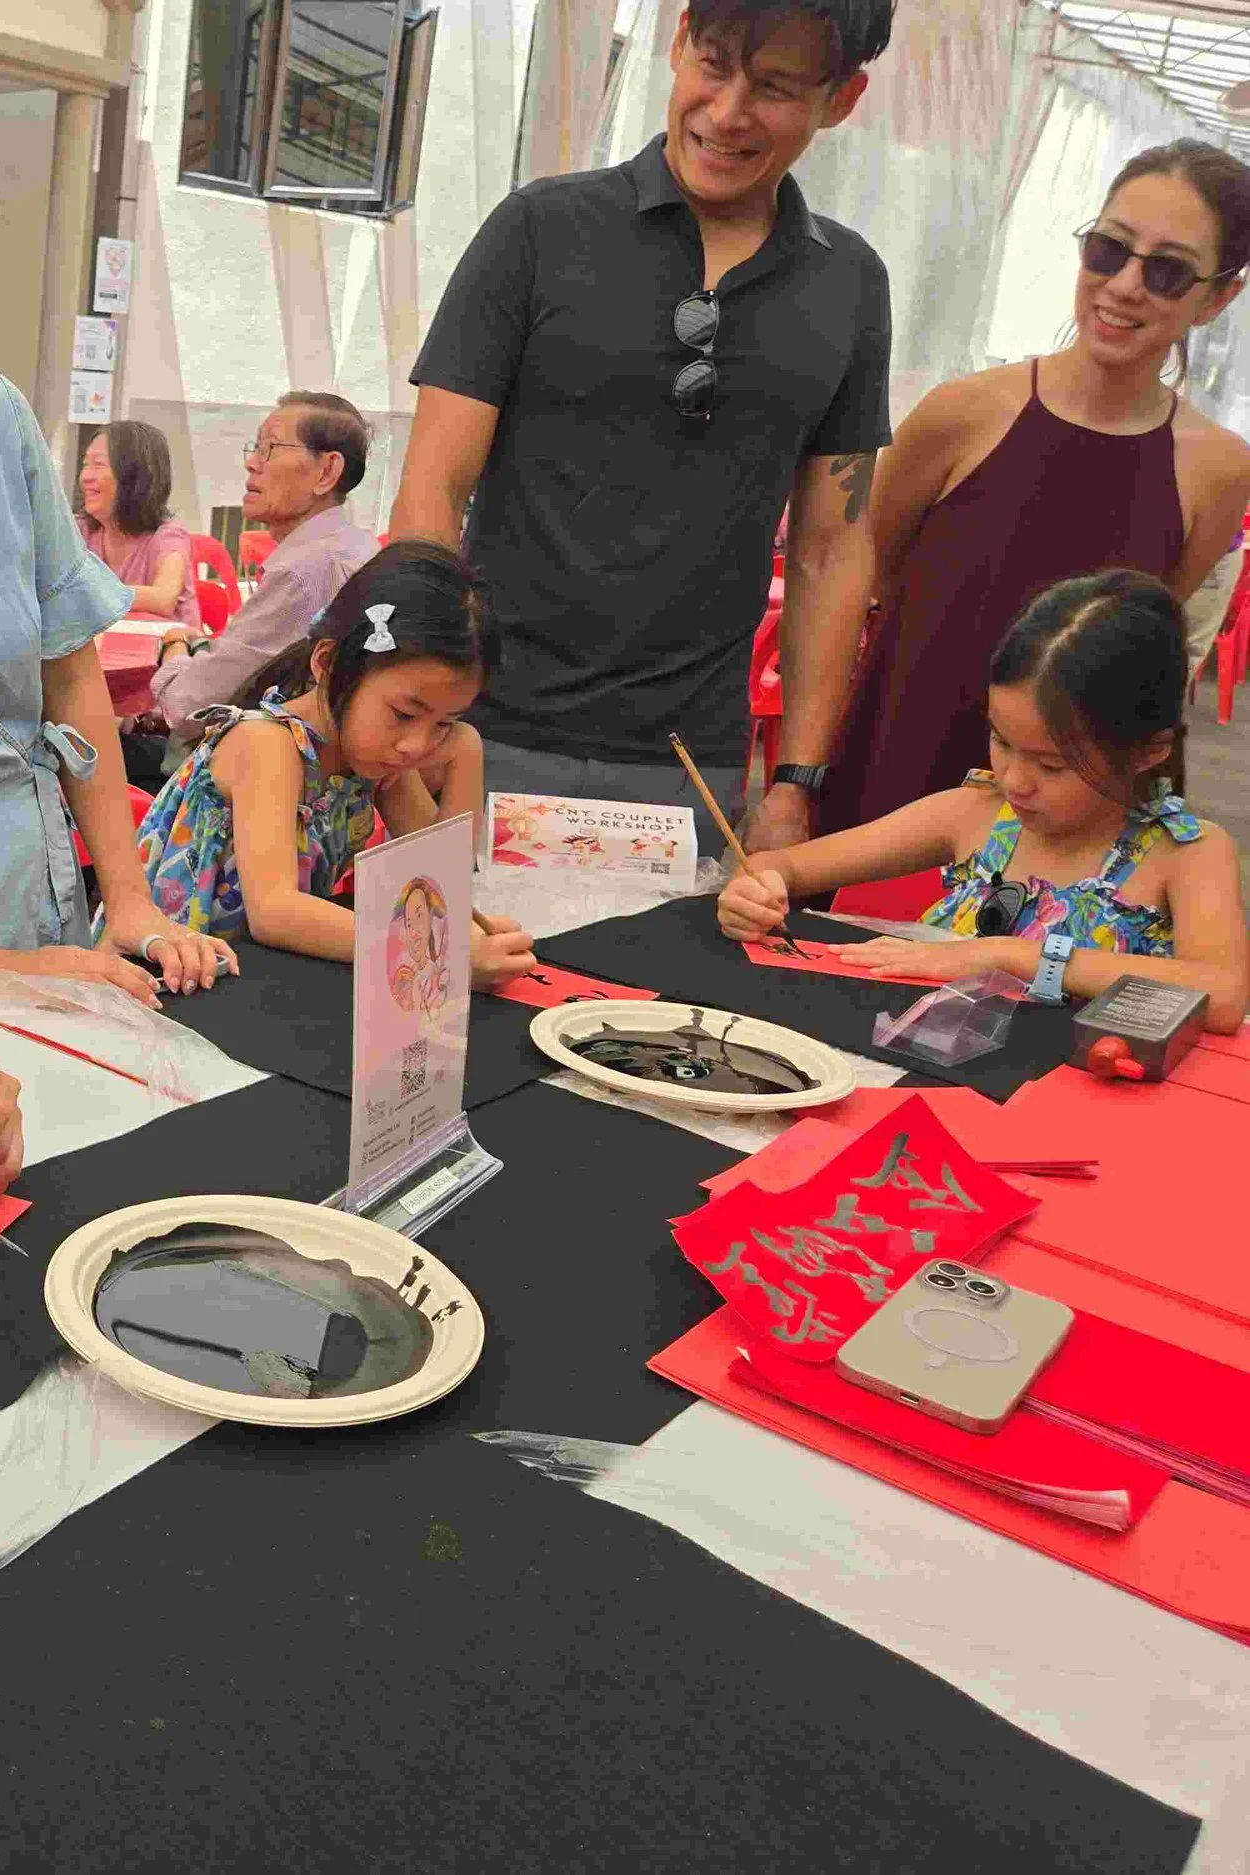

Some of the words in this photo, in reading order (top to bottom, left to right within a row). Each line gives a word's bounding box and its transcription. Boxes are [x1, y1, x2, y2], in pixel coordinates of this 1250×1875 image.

[555, 807, 591, 817] CNY
[601, 811, 686, 825] COUPLET
[566, 816, 676, 832] WORKSHOP
